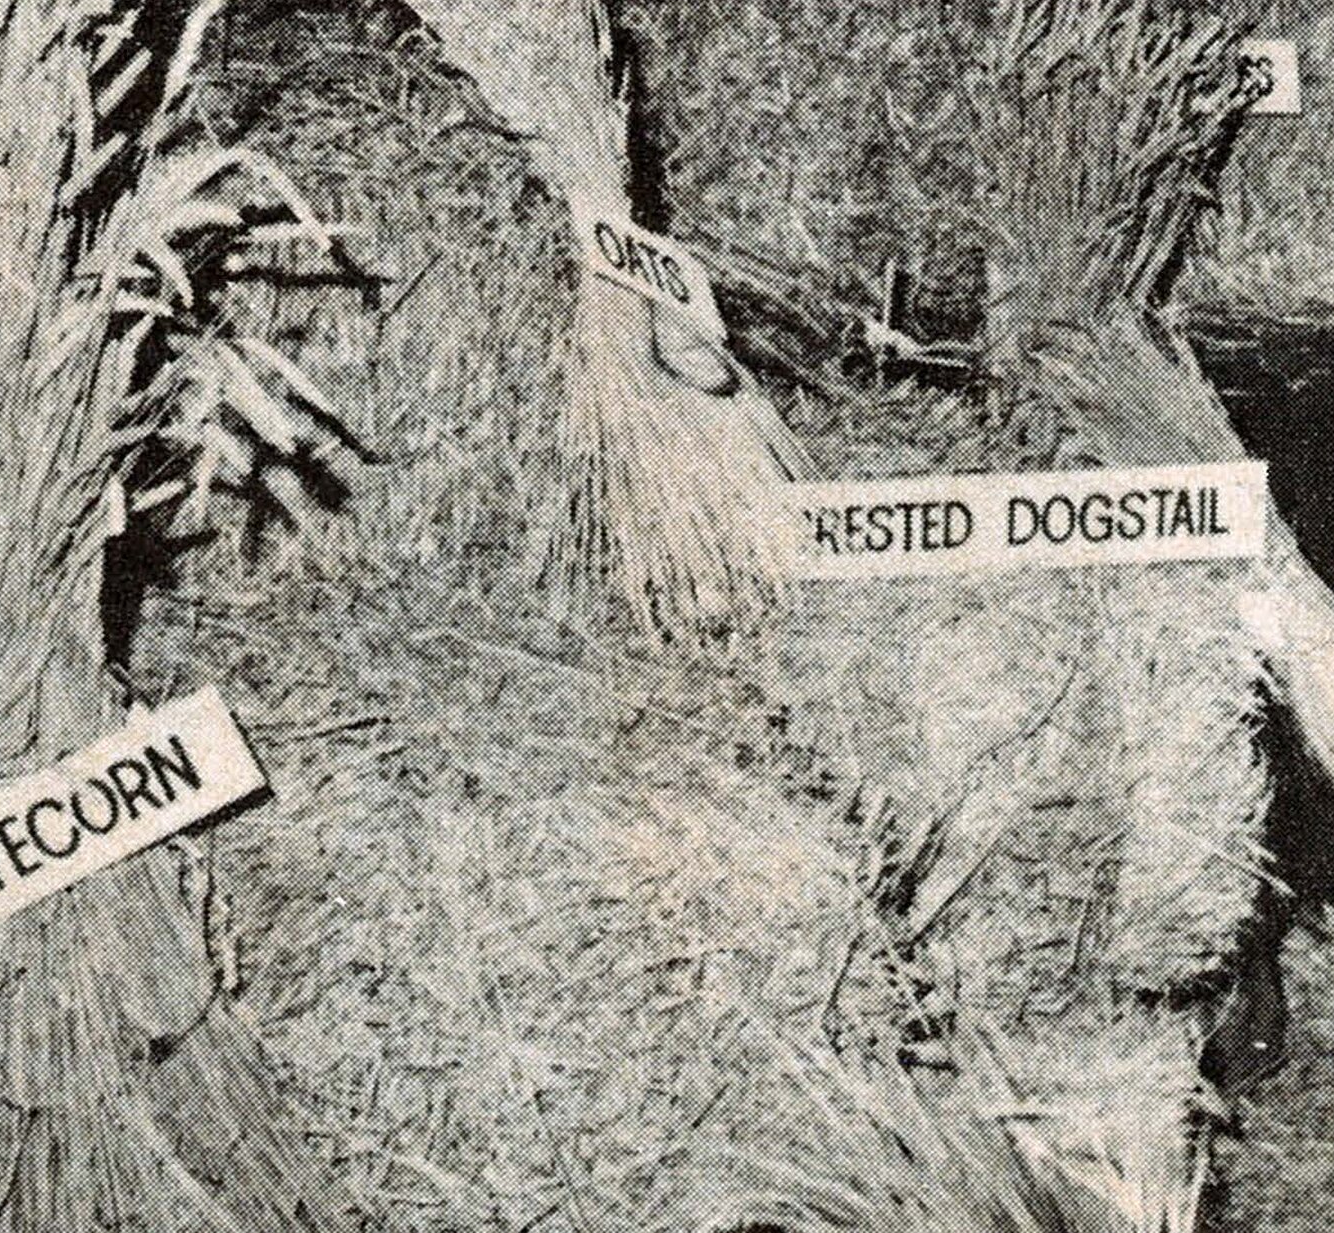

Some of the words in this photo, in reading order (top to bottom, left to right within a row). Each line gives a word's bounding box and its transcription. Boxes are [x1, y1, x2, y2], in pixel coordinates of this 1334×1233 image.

[594, 221, 689, 304] OATS
[803, 500, 974, 555] RESTED
[1008, 486, 1230, 548] DOGSTAIL
